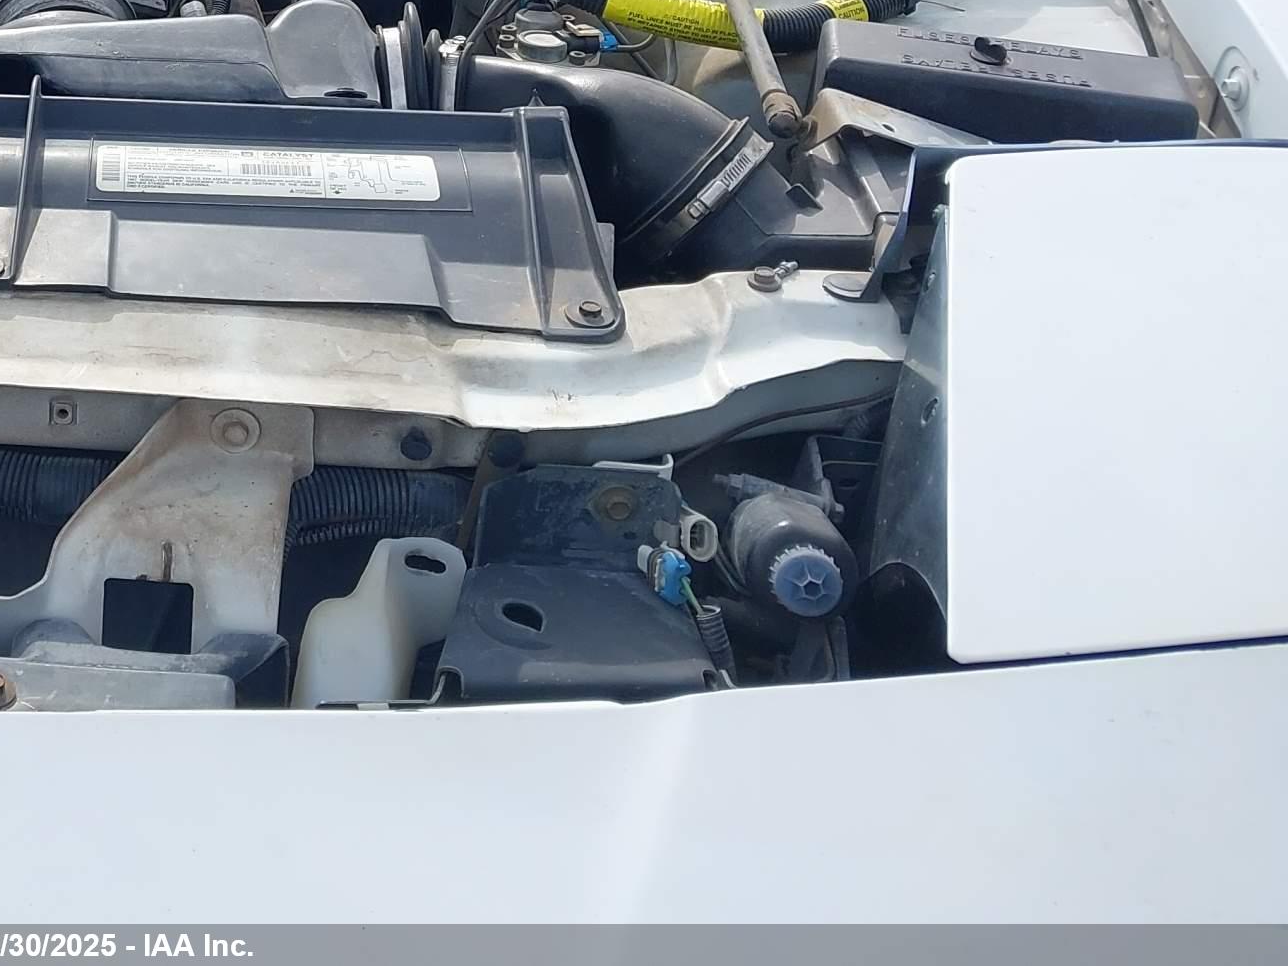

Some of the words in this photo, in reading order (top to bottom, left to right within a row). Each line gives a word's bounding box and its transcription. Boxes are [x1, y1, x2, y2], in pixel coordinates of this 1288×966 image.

[839, 7, 865, 19] CAUTION
[665, 20, 682, 28] MUST
[672, 15, 700, 25] CAUTION
